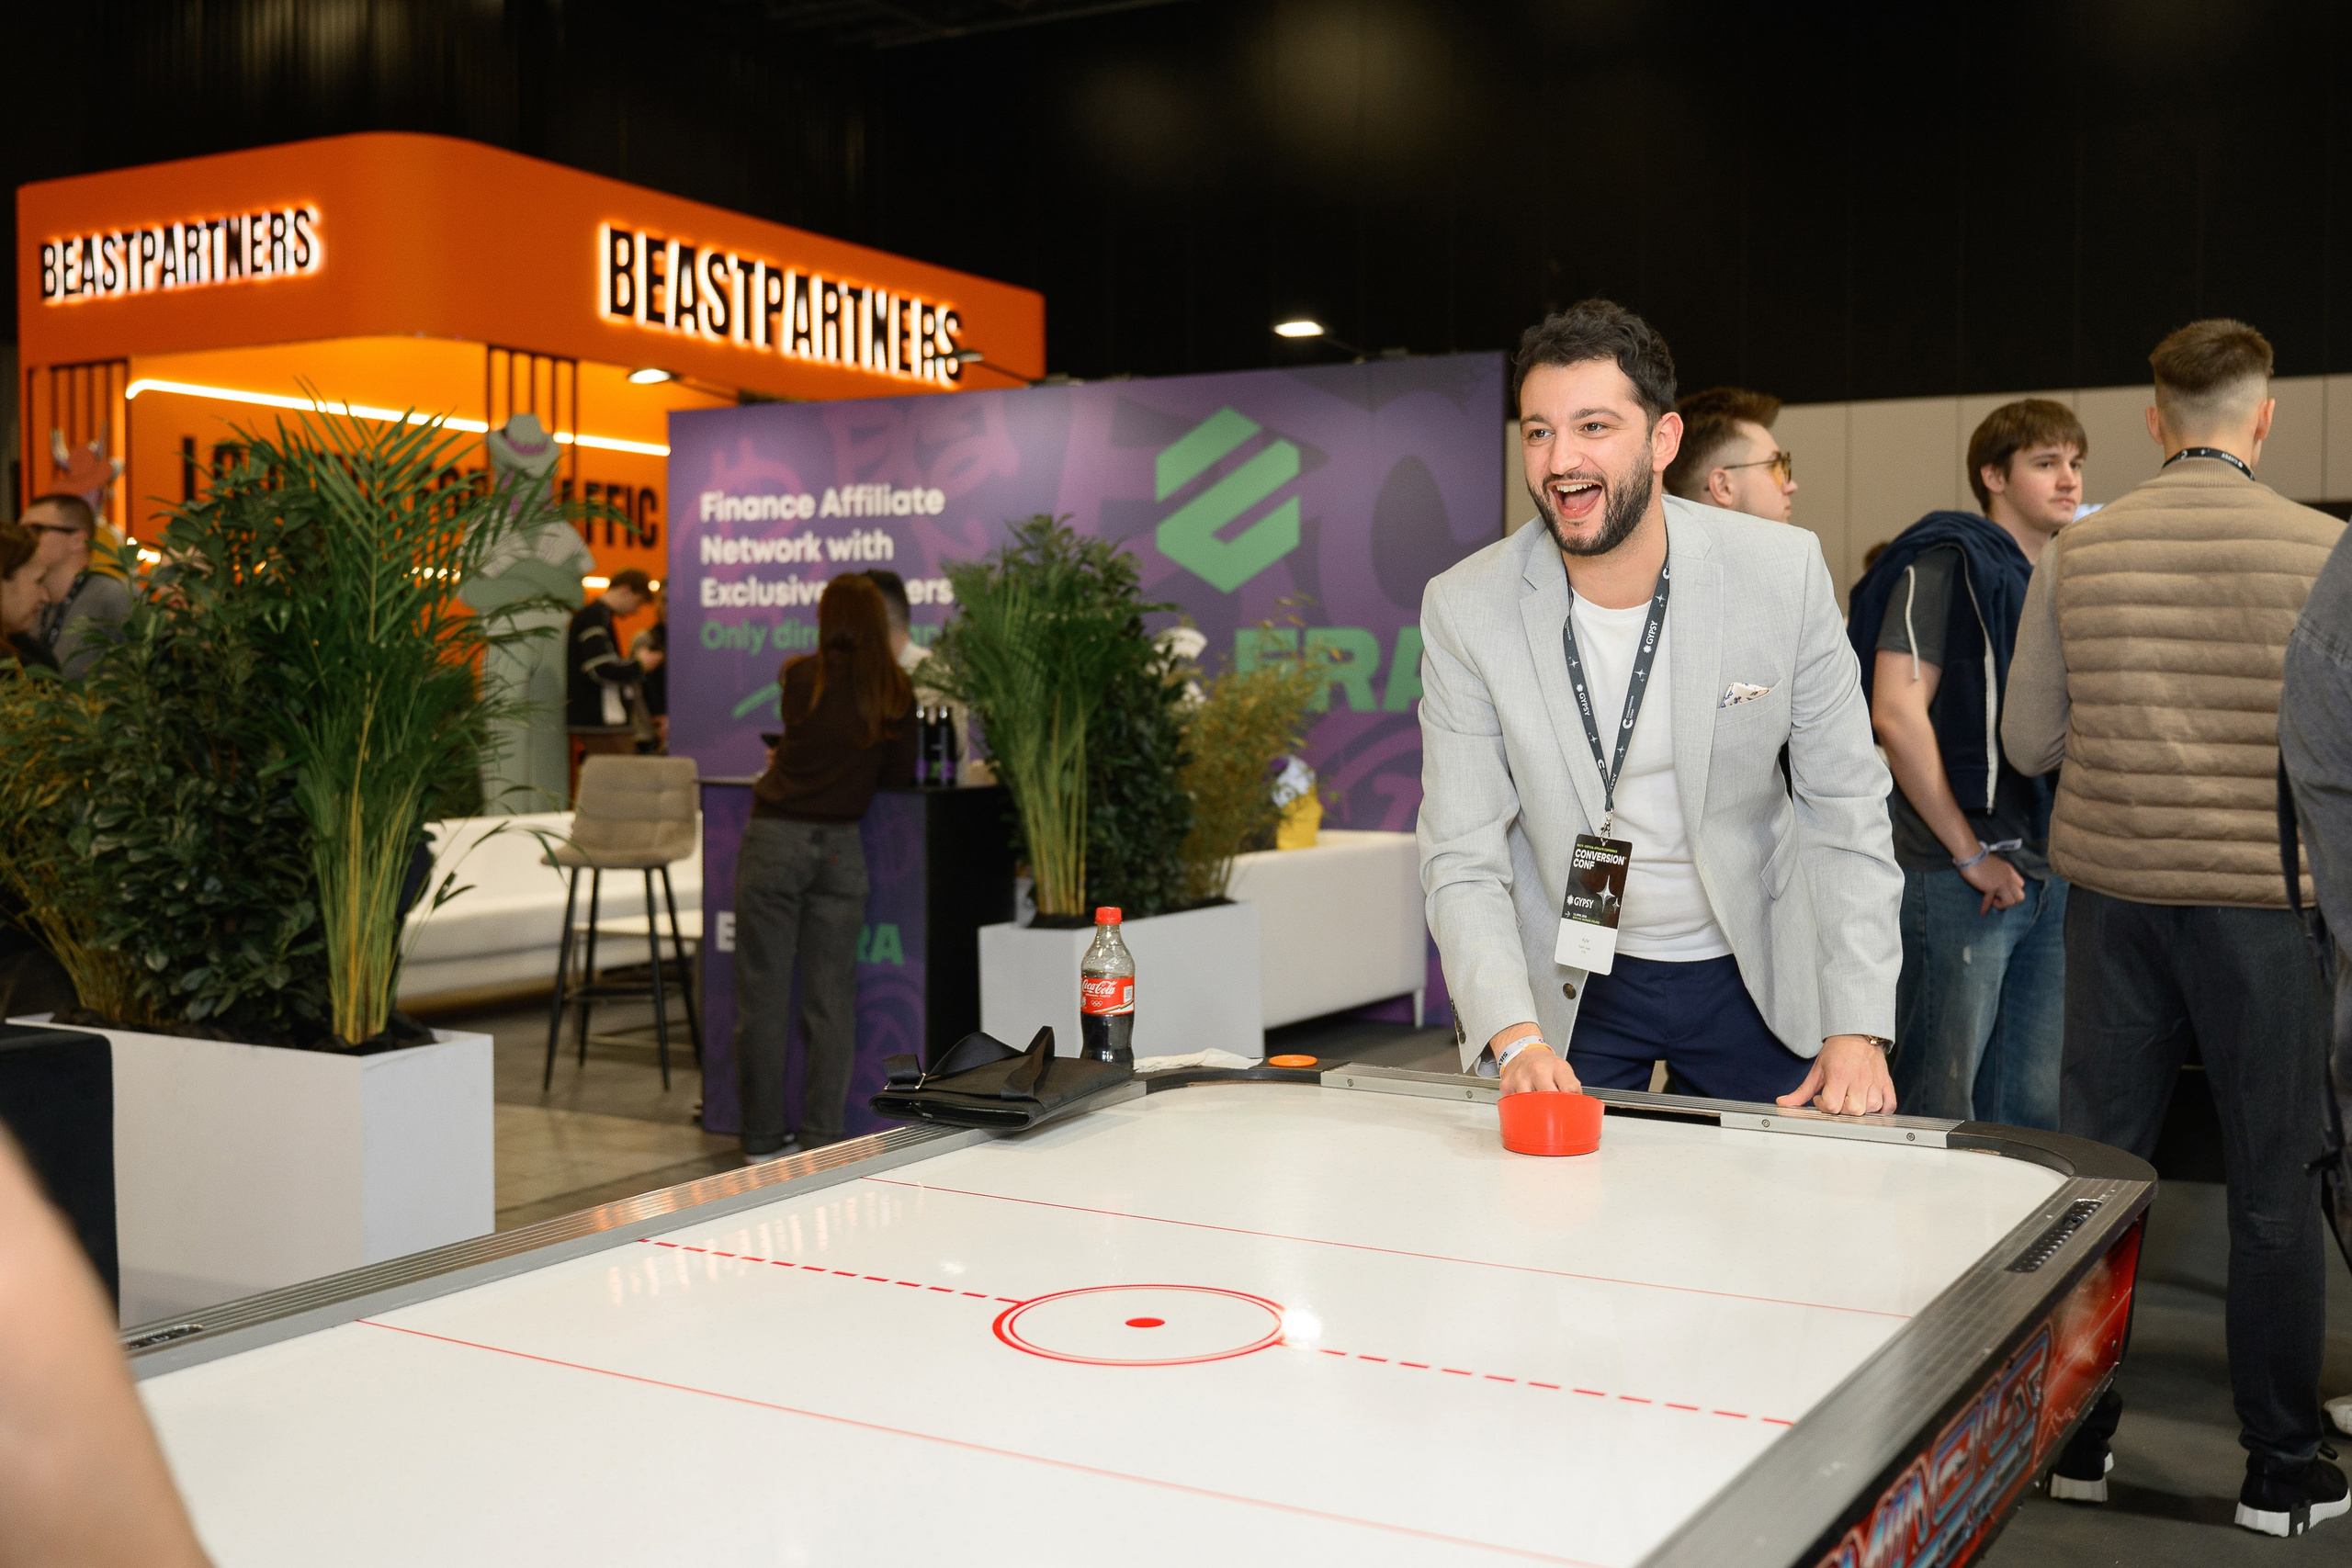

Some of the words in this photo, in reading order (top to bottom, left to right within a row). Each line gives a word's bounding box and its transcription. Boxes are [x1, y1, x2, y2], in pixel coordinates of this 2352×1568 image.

[42, 209, 314, 300] BEASTPARTNERS
[605, 224, 963, 386] BEASTPARTNERS
[700, 490, 816, 522] Finance
[820, 483, 945, 519] Affiliate
[700, 530, 823, 565] Network
[827, 527, 894, 561] with
[699, 618, 768, 656] Only
[1645, 620, 1657, 645] GYPSY
[1578, 693, 1590, 716] GYPSY
[1573, 858, 1595, 870] CONF
[1575, 848, 1625, 866] CONVERSION
[1574, 897, 1594, 909] GYPSY
[1082, 978, 1118, 995] Coca-Cola
